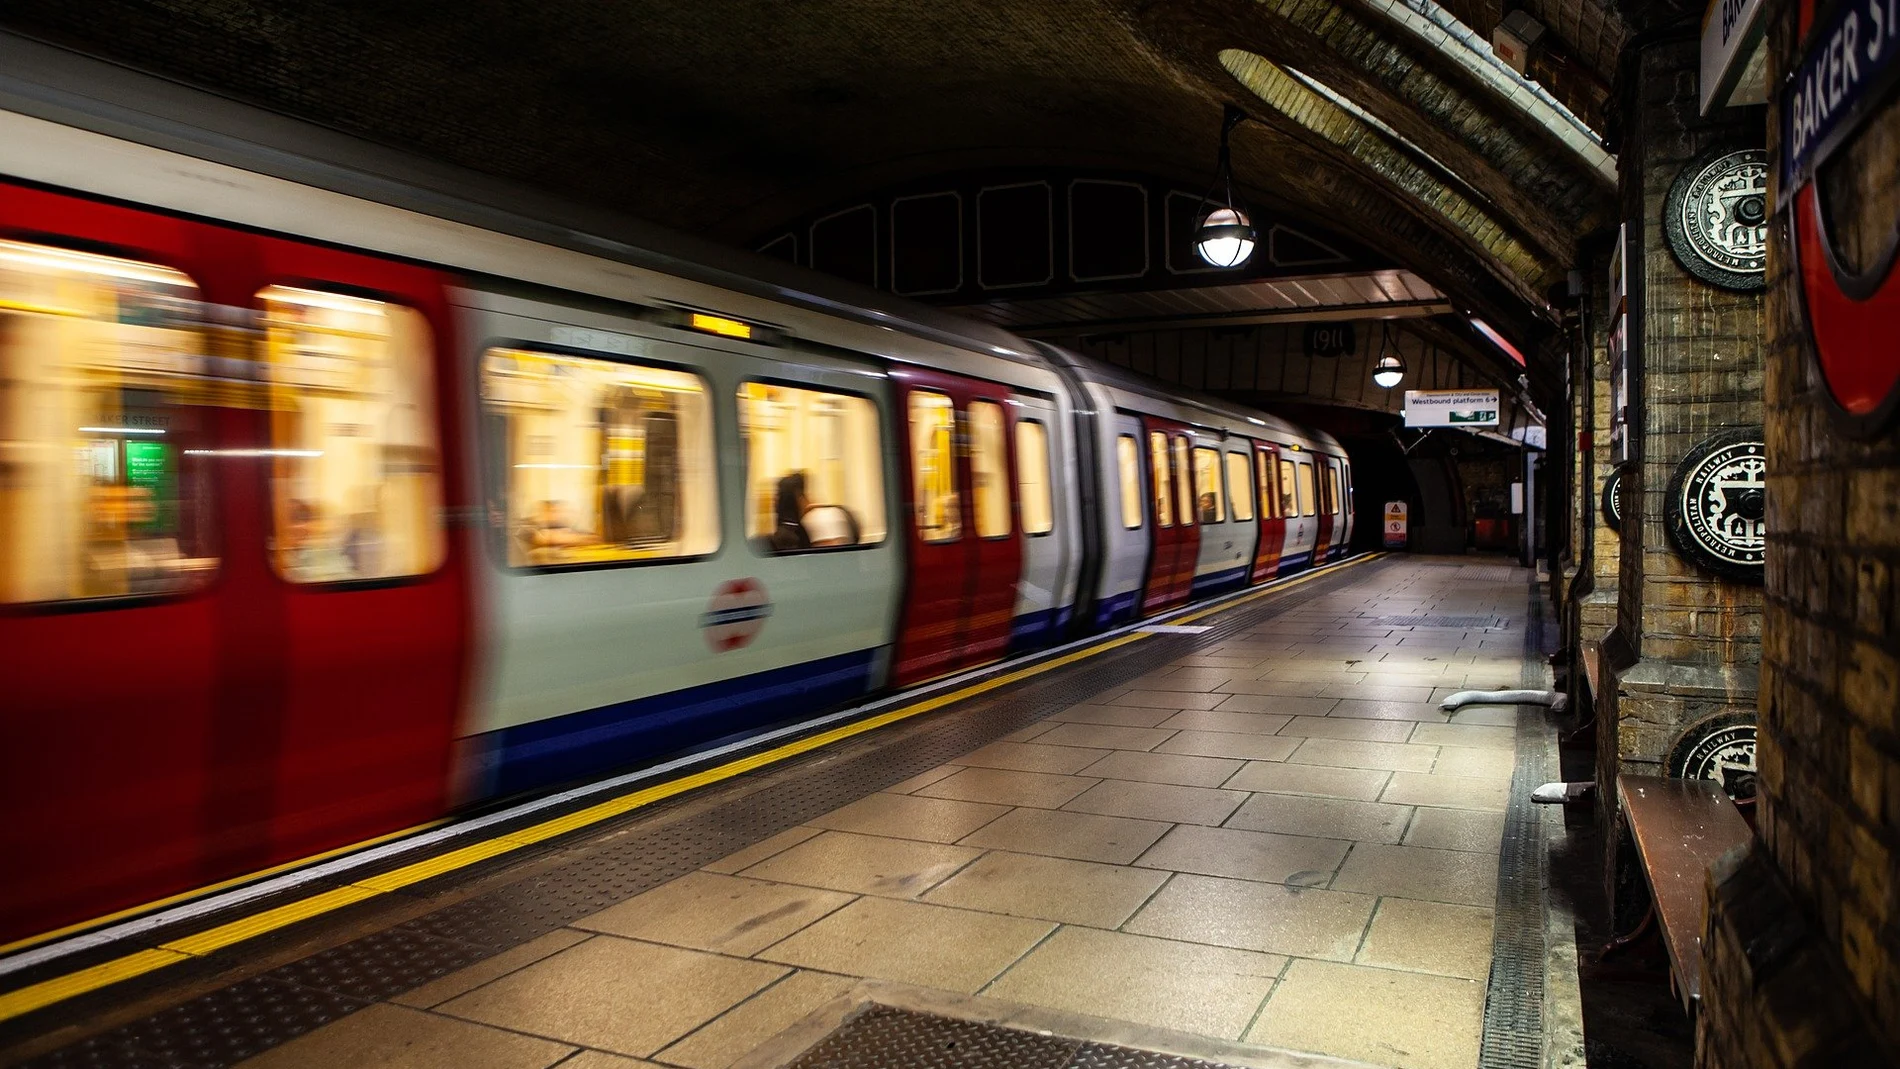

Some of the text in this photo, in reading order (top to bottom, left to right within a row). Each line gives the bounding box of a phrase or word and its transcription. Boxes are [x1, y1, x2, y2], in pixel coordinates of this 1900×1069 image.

[1722, 0, 1746, 47] BAK
[1793, 10, 1859, 160] BAKER
[1313, 329, 1344, 351] 1911
[1412, 397, 1451, 405] Westbound
[1452, 396, 1483, 405] platform
[132, 415, 170, 427] STREET
[1689, 451, 1736, 557] METROPOLITAN RAILWAY
[1696, 732, 1736, 760] RAILWAY
